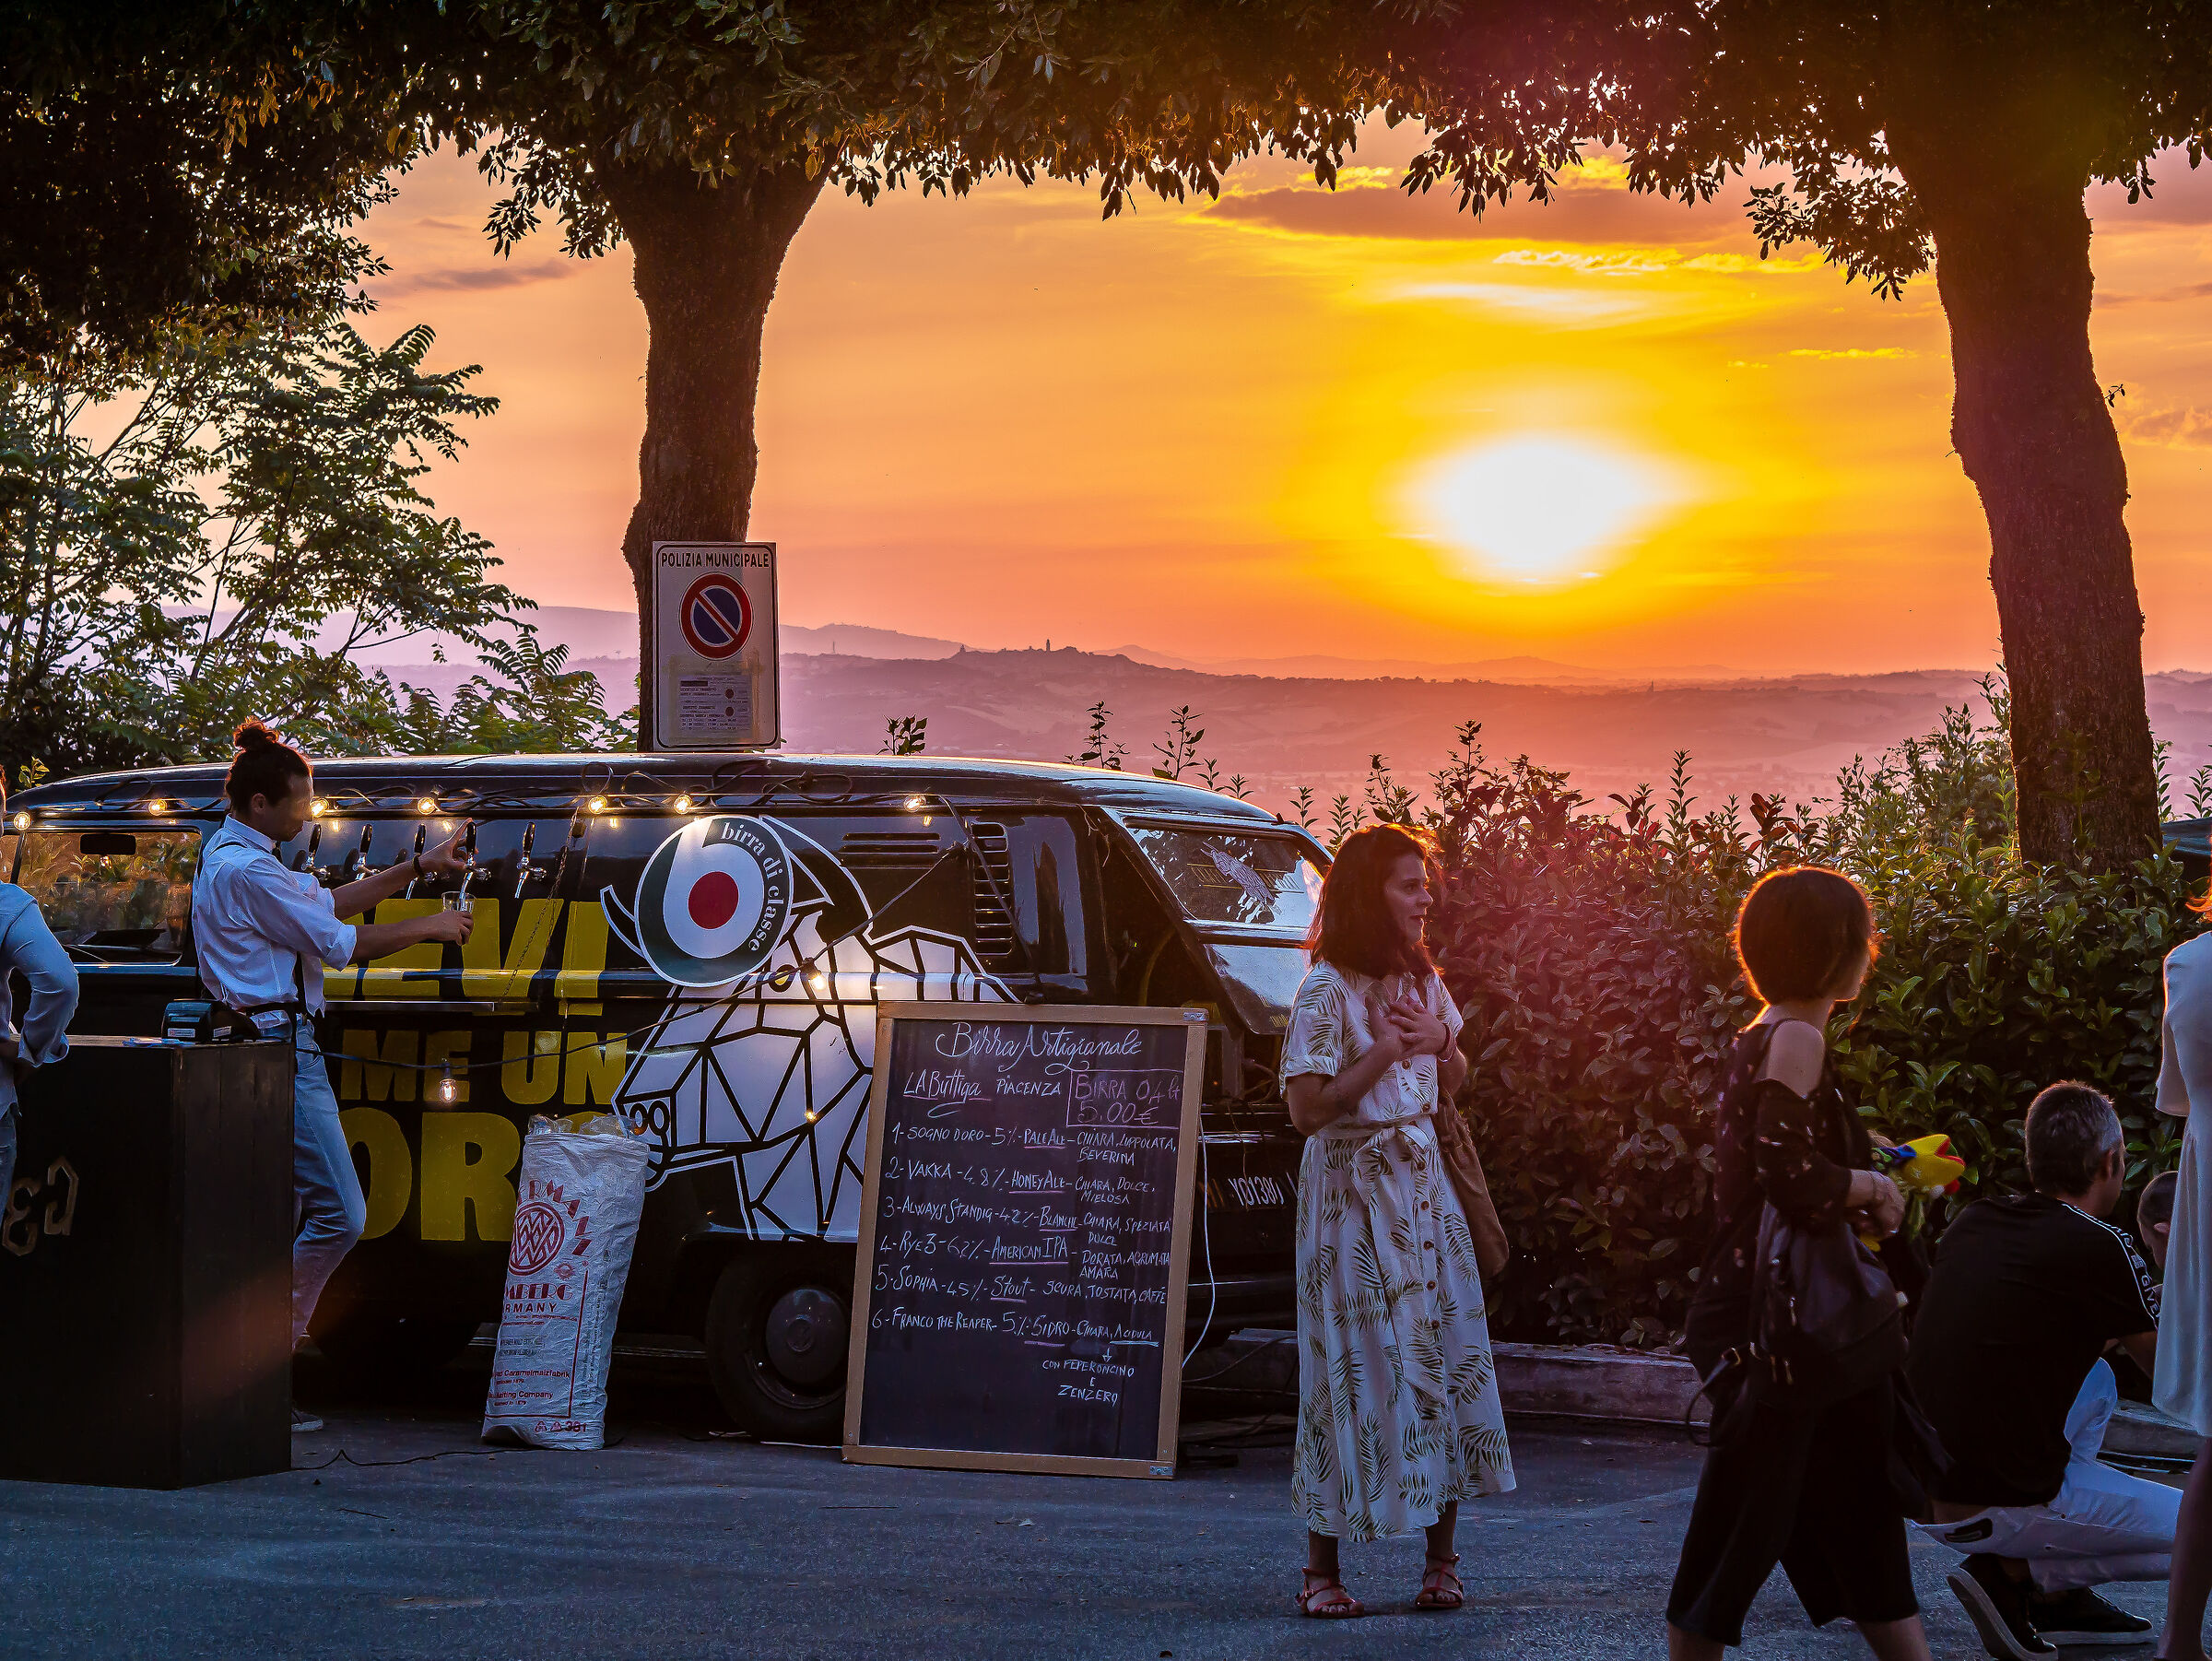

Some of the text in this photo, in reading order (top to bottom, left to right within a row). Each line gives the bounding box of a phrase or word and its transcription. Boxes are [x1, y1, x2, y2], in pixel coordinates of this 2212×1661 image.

[661, 553, 770, 568] POLIZIA MUNICIPALE
[721, 822, 784, 952] birra di classe
[935, 1021, 1143, 1075] Birra Artigianale
[501, 1031, 627, 1104] UN
[1075, 1074, 1126, 1100] BIRRA
[907, 1127, 950, 1140] SOGNO
[1077, 1146, 1135, 1165] BEVERINA
[908, 1160, 951, 1180] VAKKA
[1042, 1236, 1068, 1259] IPA
[1079, 1266, 1118, 1279] AMARA
[892, 1306, 934, 1330] FRANCO
[519, 1391, 553, 1399] Company
[1058, 1384, 1118, 1407] ZENZERO
